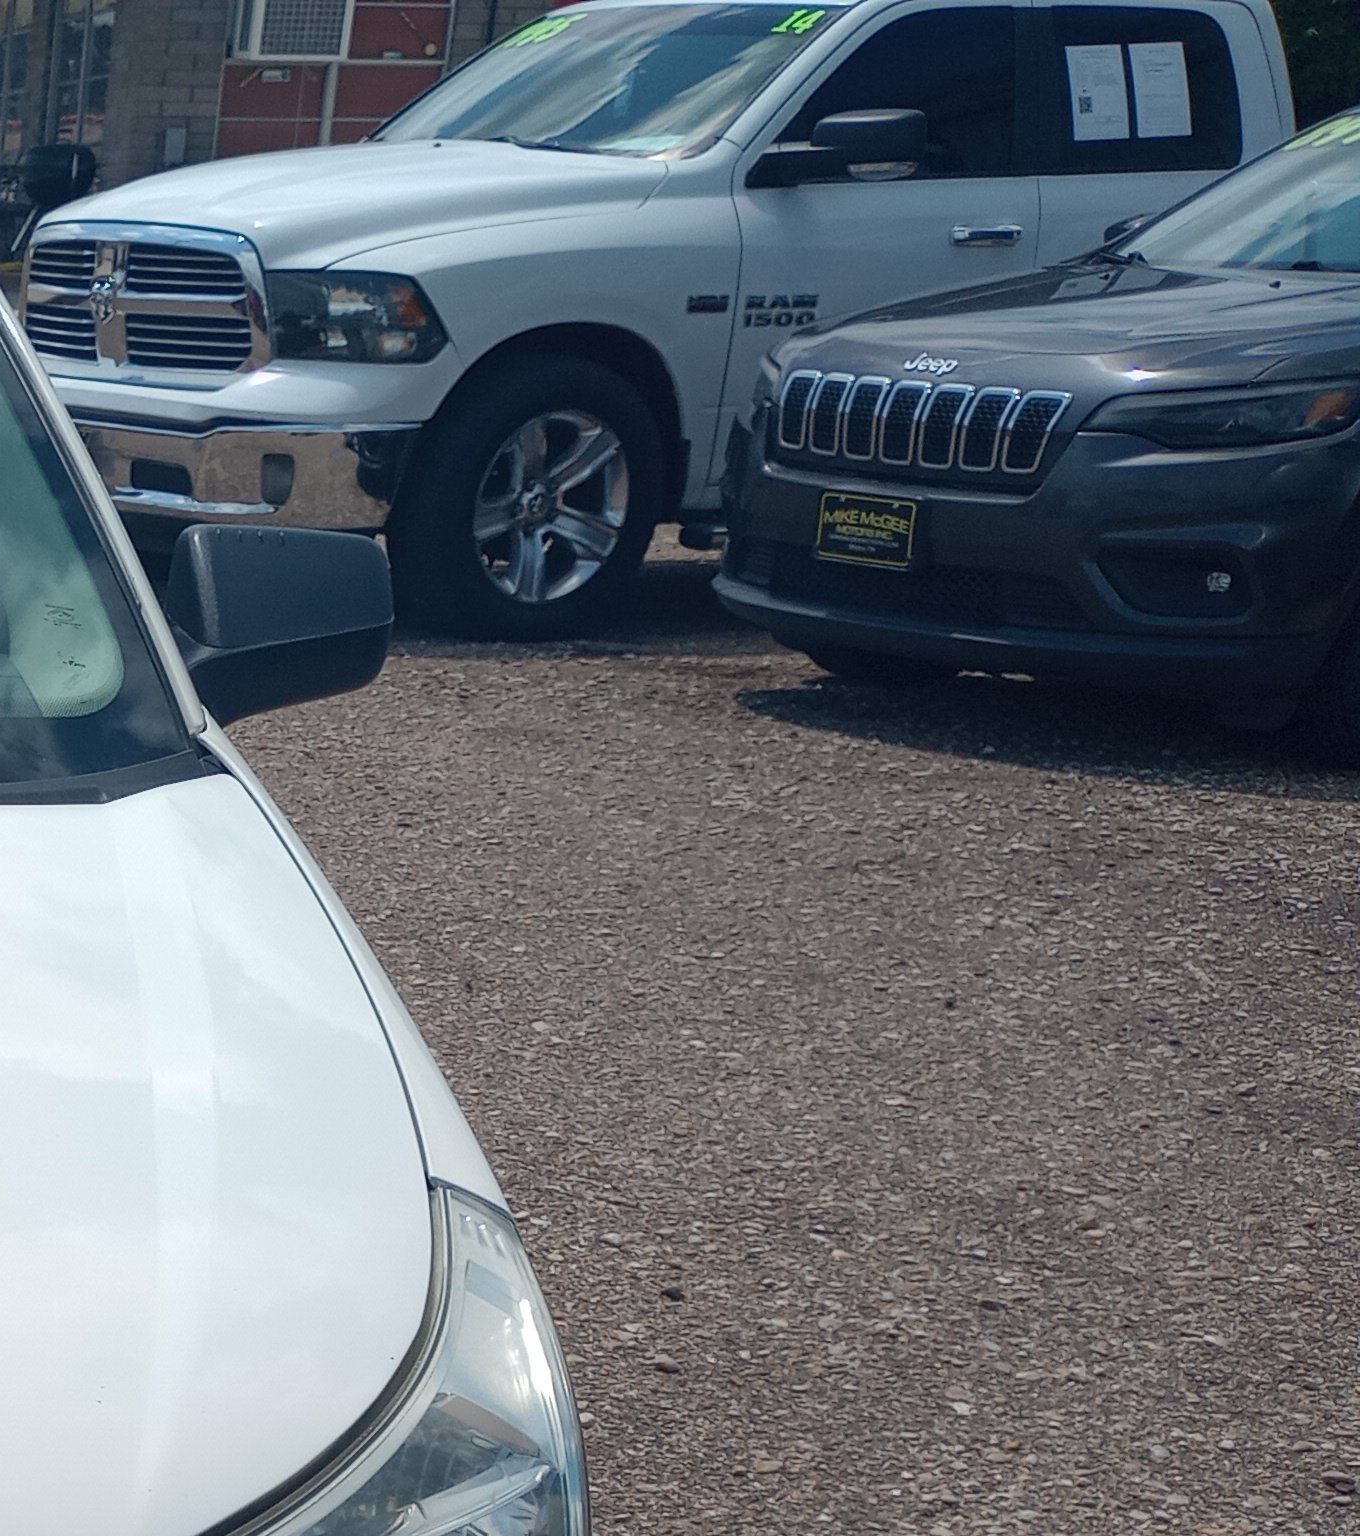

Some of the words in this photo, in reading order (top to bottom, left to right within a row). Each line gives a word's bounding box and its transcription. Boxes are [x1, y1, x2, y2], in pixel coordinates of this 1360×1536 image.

[771, 9, 826, 35] 14
[744, 311, 816, 327] 1500
[904, 352, 959, 376] Jeep
